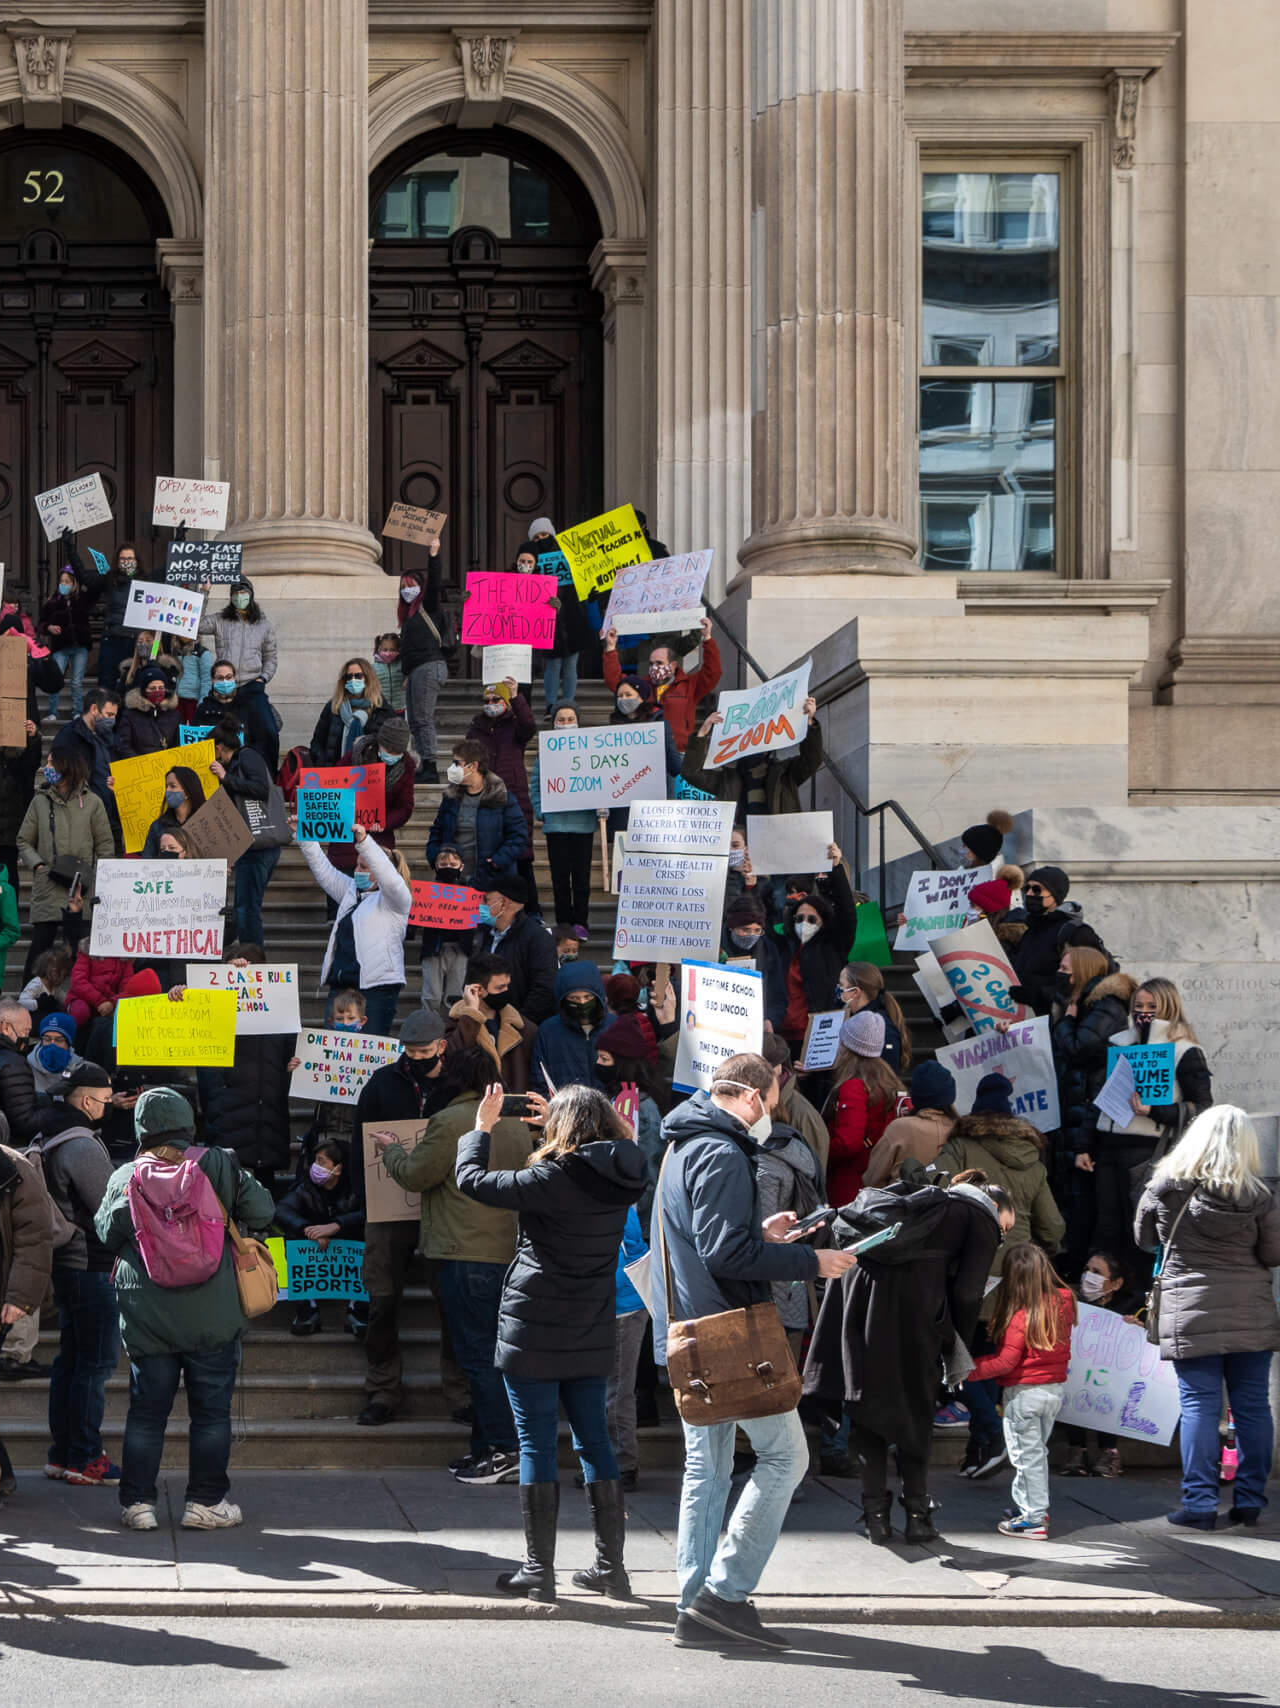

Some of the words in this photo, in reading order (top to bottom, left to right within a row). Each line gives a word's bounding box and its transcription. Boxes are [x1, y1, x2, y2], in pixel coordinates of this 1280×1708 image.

[23, 170, 64, 203] 52
[159, 480, 185, 492] OPEN
[562, 521, 621, 555] VIRTUAL
[598, 534, 632, 554] TEACHES
[171, 543, 195, 553] NO
[212, 553, 239, 561] RULE
[170, 560, 193, 570] NO
[211, 562, 239, 570] FEET
[622, 557, 700, 585] OPEN
[201, 574, 240, 582] SCHOOLS
[472, 577, 507, 603] THE
[515, 576, 553, 606] KIDS
[133, 590, 200, 614] EDUCATION
[148, 609, 197, 632] FIRST!
[466, 611, 530, 639] ZOOMED
[533, 618, 556, 640] OUT
[722, 680, 798, 736] ROOM
[547, 735, 588, 752] OPEN
[594, 729, 657, 749] SCHOOLS
[712, 714, 796, 765] ZOOM
[571, 756, 581, 771] 5
[590, 753, 629, 769] DAYS
[349, 766, 367, 792] 2
[547, 777, 565, 793] NO
[569, 775, 602, 793] ZOOM
[610, 773, 621, 784] IN
[611, 765, 652, 799] CLASSROOM
[304, 792, 341, 800] REOPEN
[305, 802, 340, 810] SAFELY.
[641, 806, 674, 815] CLOSED
[676, 806, 718, 817] SCHOOLS
[305, 812, 340, 820] REOPEN
[301, 822, 348, 839] NOW.
[632, 819, 690, 829] EXACERBATE
[691, 819, 722, 830] WHICH
[632, 834, 644, 842] OF
[646, 834, 660, 843] THE
[638, 859, 673, 867] MENTAL
[676, 860, 713, 871] HEALTH
[655, 870, 686, 879] CRISES
[133, 880, 174, 894] SAFE
[918, 878, 930, 892] I
[939, 872, 979, 889] DON'T
[430, 884, 468, 902] 365
[634, 886, 678, 896] LEARNING
[682, 888, 704, 897] LOSS
[676, 903, 705, 912] RATES
[949, 901, 959, 910] A
[631, 917, 664, 928] GENDER
[668, 920, 712, 930] INEQUITY
[122, 929, 222, 956] UNETHICAL
[629, 934, 644, 943] ALL
[646, 935, 657, 944] OF
[660, 936, 678, 946] THE
[680, 937, 711, 948] ABOVE
[209, 972, 219, 985] 2
[227, 971, 263, 985] CASE
[268, 971, 292, 983] RULE
[971, 964, 990, 981] 2
[731, 983, 756, 998] SCHOOL
[236, 1002, 269, 1012] SCHOOL
[720, 1003, 748, 1017] UNCOOL
[159, 1009, 211, 1023] CLASSROOM
[307, 1033, 328, 1046] ONE
[333, 1036, 359, 1048] YEAR
[362, 1040, 374, 1049] IS
[377, 1041, 405, 1053] MORE
[950, 1026, 1035, 1070] VACCINATE
[323, 1049, 352, 1061] THAN
[359, 1053, 394, 1065] ENOUGH
[1141, 1051, 1149, 1059] IS
[1151, 1050, 1169, 1059] THE
[304, 1062, 331, 1072] OPEN
[1146, 1060, 1158, 1068] TO
[325, 1074, 351, 1083] DAYS
[356, 1077, 364, 1085] A
[330, 1086, 357, 1096] NOW
[333, 1246, 342, 1254] IS
